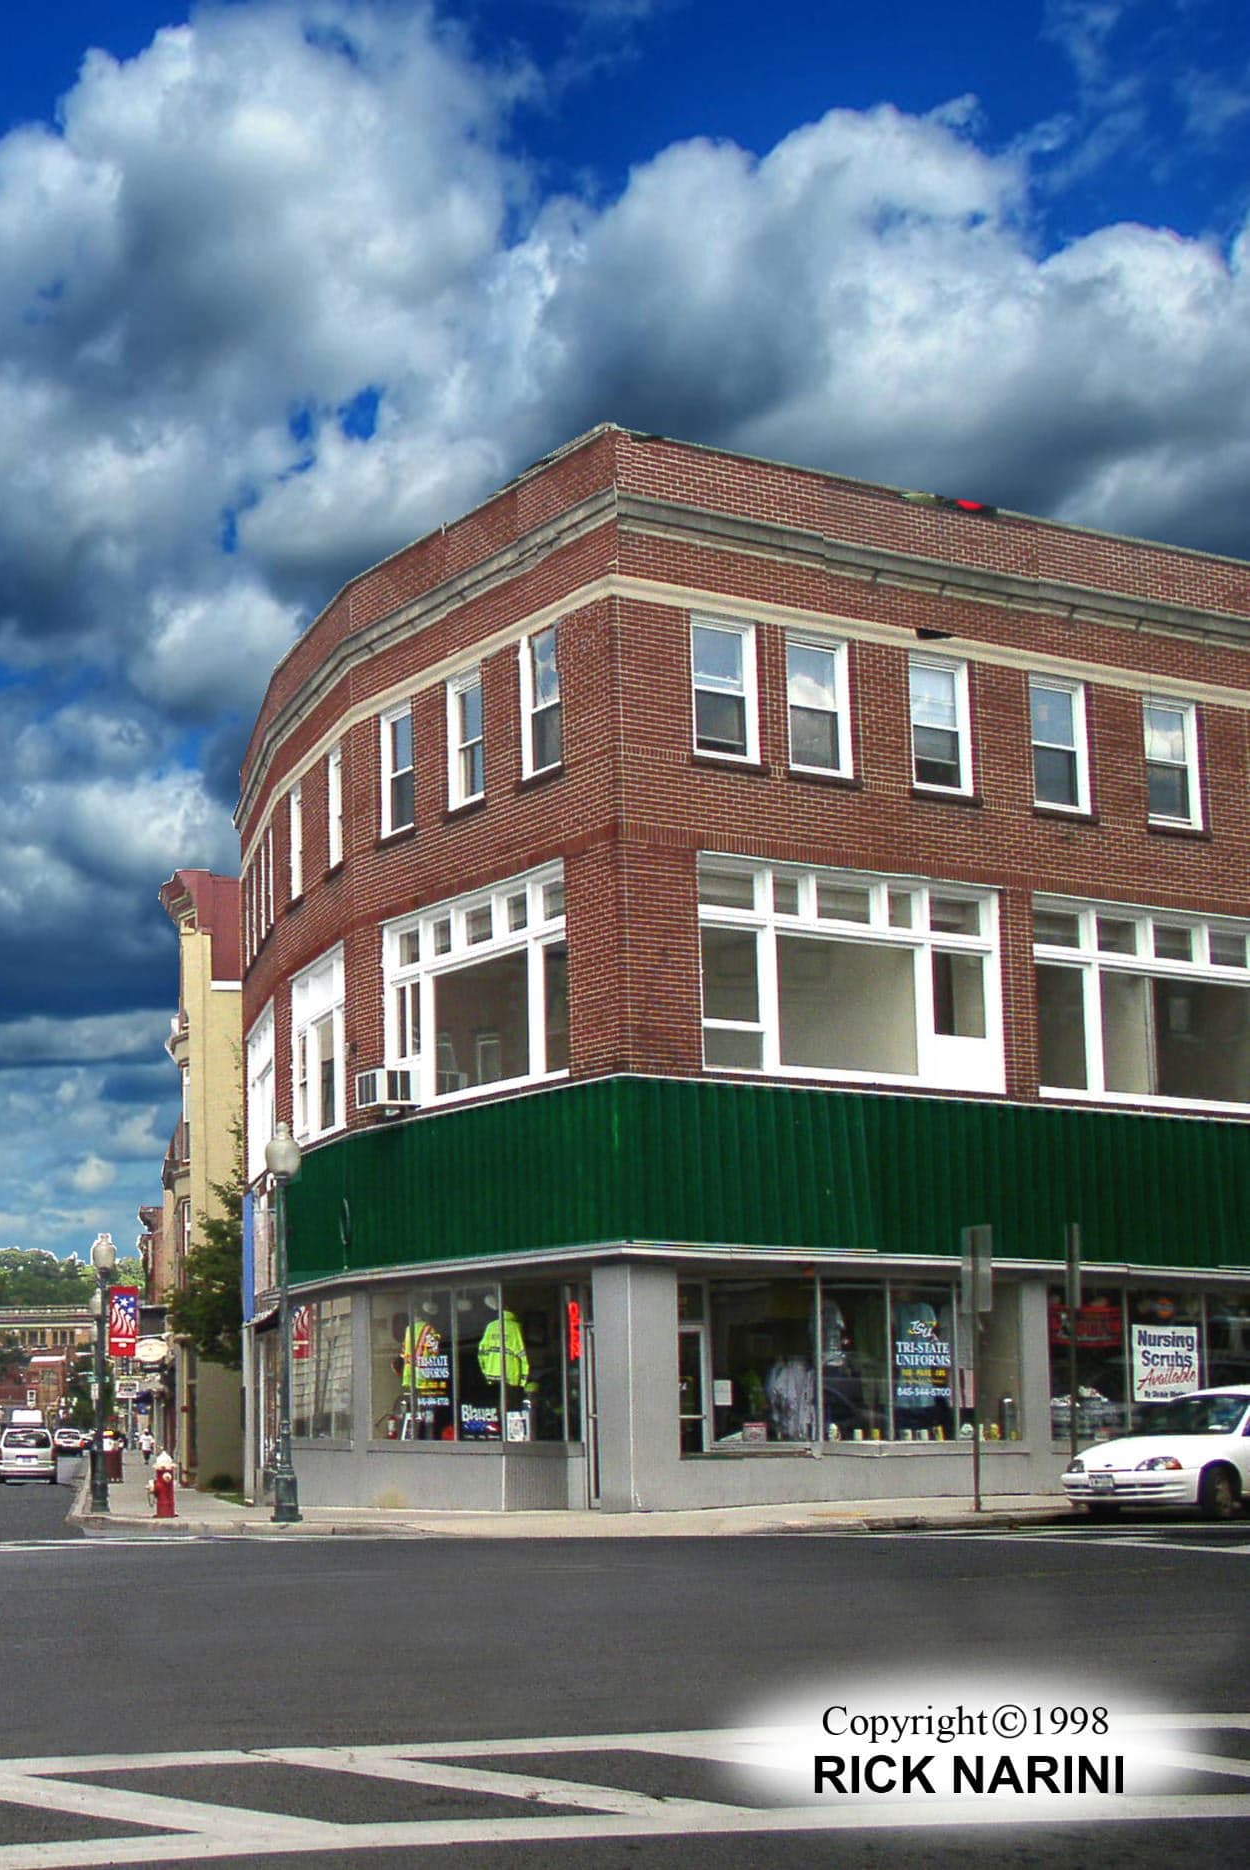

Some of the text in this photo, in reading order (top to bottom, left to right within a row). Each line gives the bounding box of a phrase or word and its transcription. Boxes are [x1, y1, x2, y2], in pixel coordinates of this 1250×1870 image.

[895, 1341, 950, 1354] TRI-STATE
[1137, 1329, 1195, 1352] Nursing
[895, 1354, 951, 1367] UNIFORMS
[1141, 1350, 1193, 1369] Scrubs
[1136, 1368, 1196, 1391] Available
